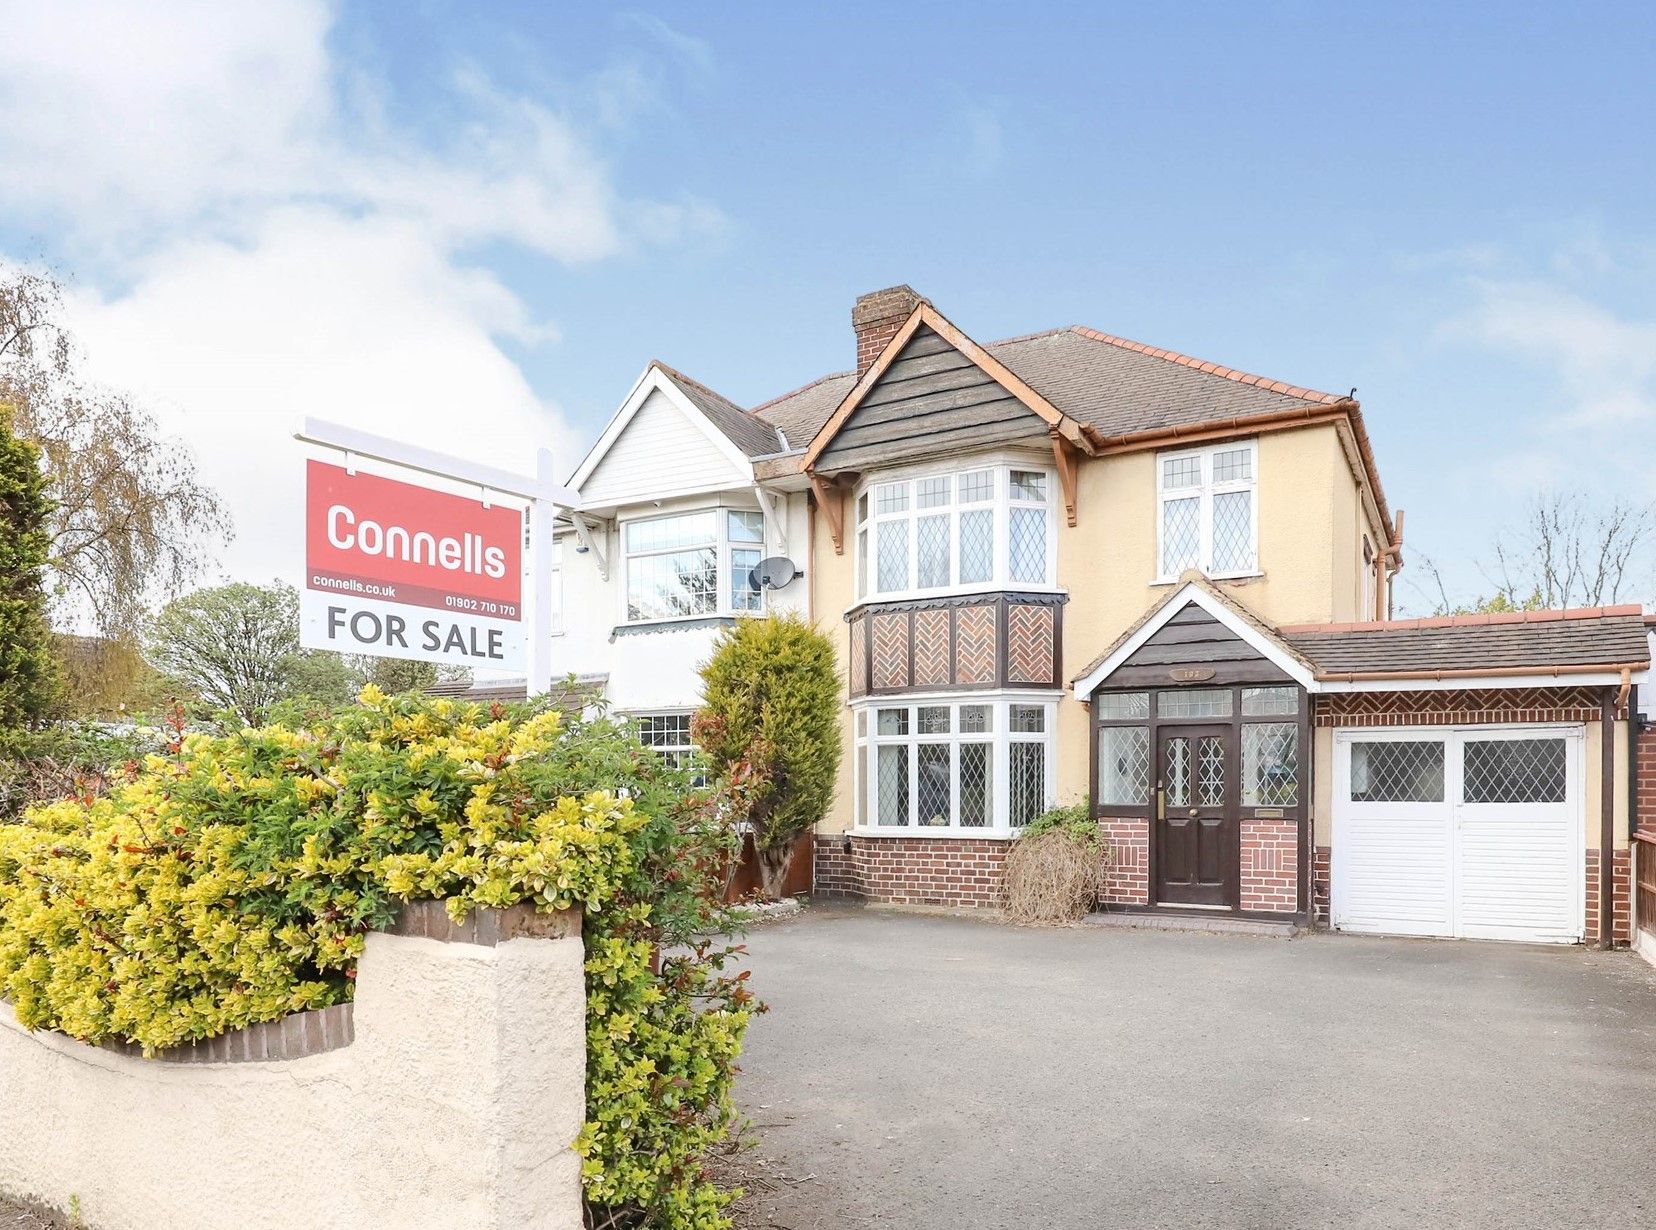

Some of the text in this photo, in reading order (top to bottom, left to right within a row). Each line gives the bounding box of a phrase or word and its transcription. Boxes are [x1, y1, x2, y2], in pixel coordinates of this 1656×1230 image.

[327, 504, 506, 579] Connells
[313, 575, 396, 598] connells.co.uk
[445, 595, 516, 617] 01902 710 170
[328, 606, 504, 660] FOR SALE
